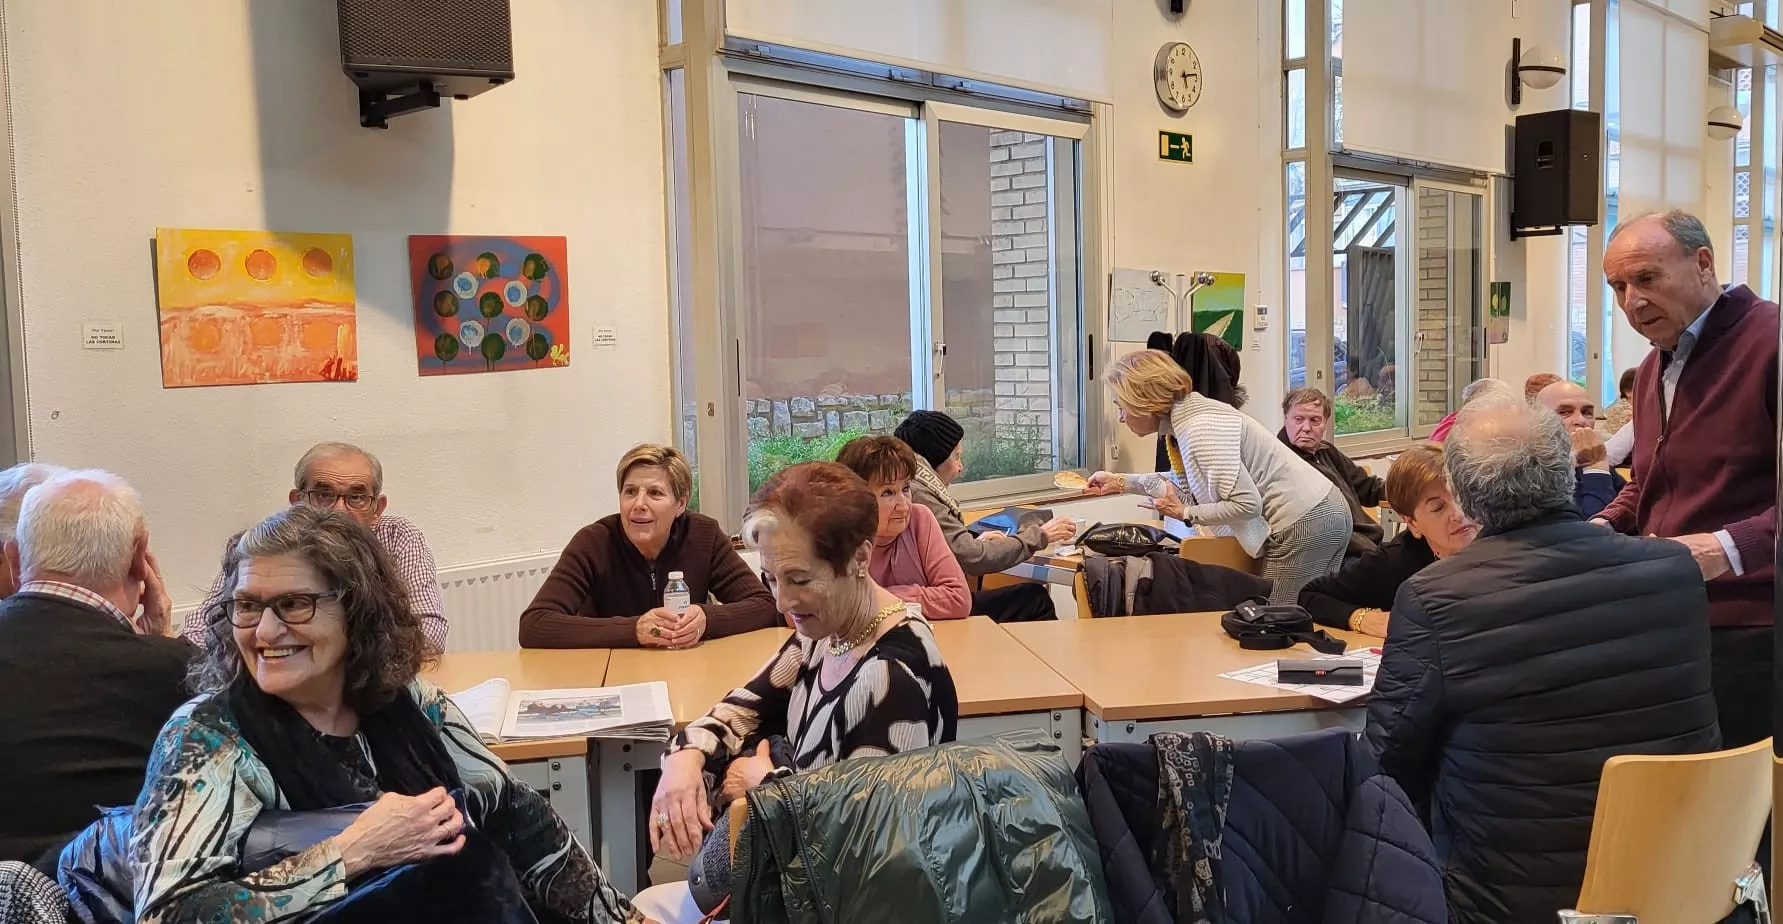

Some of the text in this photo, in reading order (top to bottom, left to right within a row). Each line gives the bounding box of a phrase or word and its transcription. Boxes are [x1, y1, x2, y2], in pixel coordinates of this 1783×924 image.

[1192, 60, 1197, 69] 2
[1192, 85, 1196, 94] 4
[1181, 94, 1186, 103] 6
[1187, 93, 1192, 102] 5
